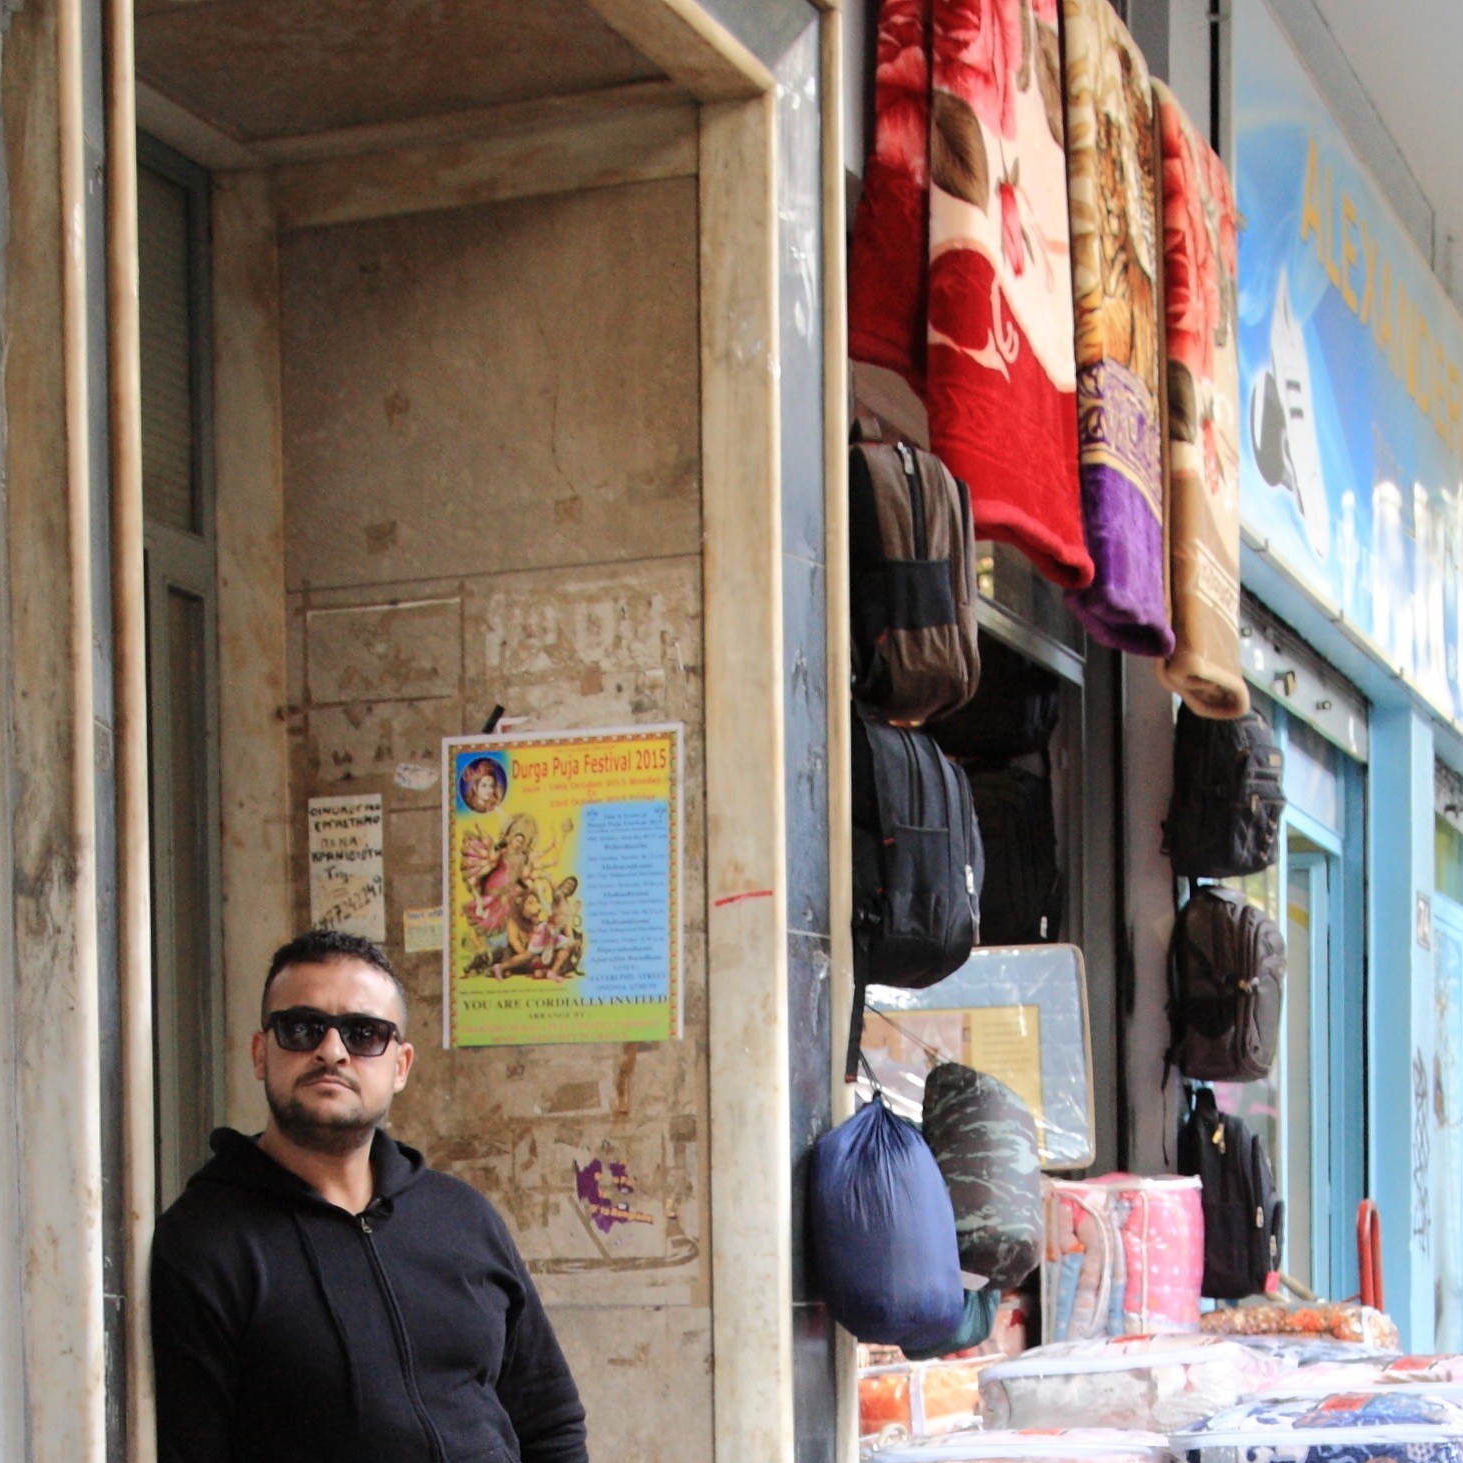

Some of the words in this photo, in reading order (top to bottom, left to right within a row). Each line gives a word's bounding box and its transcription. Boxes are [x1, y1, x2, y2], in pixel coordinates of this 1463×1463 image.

[511, 759, 548, 783] Durga
[552, 755, 579, 780] Puja
[584, 750, 631, 773] Festival
[636, 748, 666, 770] 2015
[463, 1000, 488, 1011] YOU
[496, 999, 520, 1010] ARE
[525, 996, 604, 1009] CORDIALLY
[610, 994, 668, 1006] INVITED
